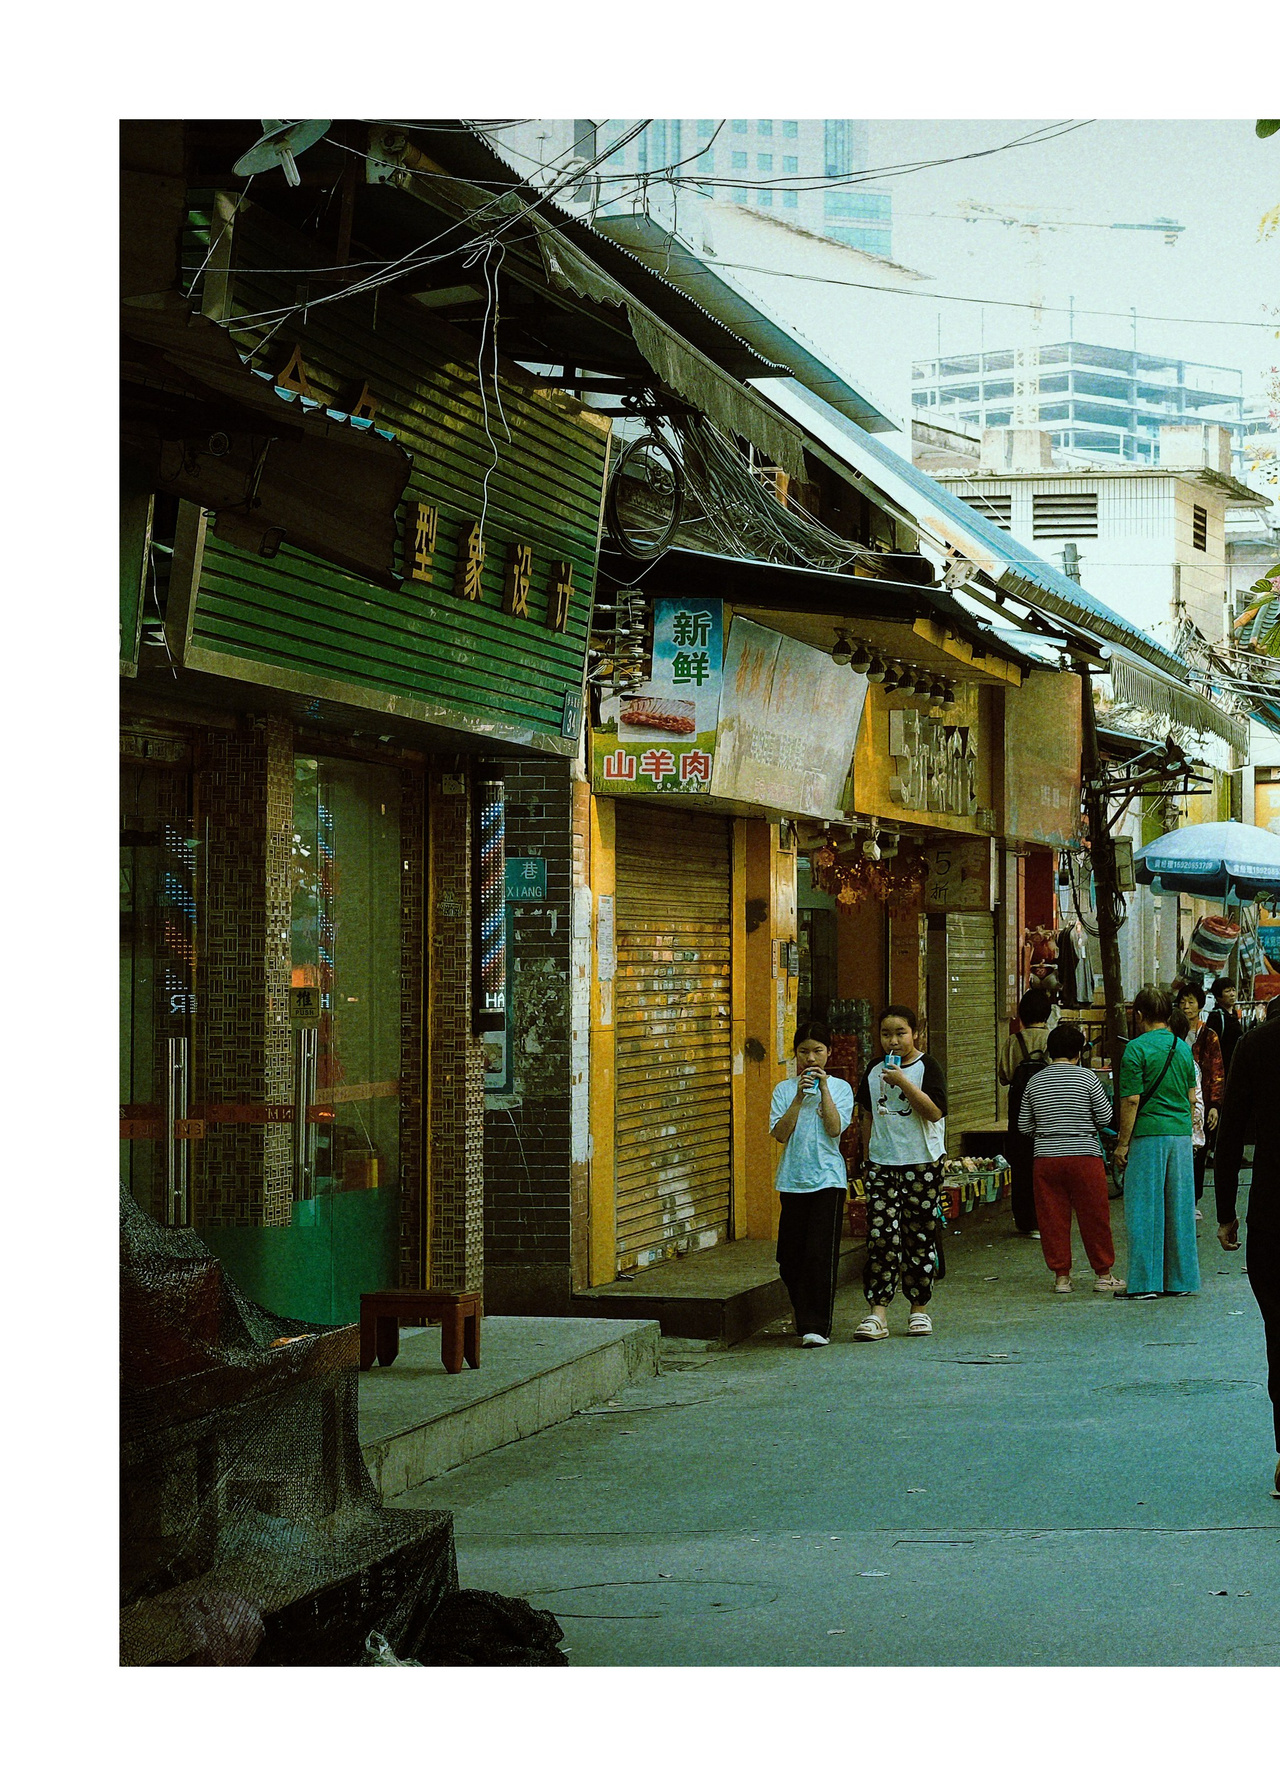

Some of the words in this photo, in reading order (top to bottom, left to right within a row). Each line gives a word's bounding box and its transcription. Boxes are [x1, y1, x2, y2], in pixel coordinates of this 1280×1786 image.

[671, 601, 712, 687] 新鲜
[604, 750, 712, 781] 山羊肉
[506, 886, 543, 898] XIANG
[297, 990, 313, 1007] 推
